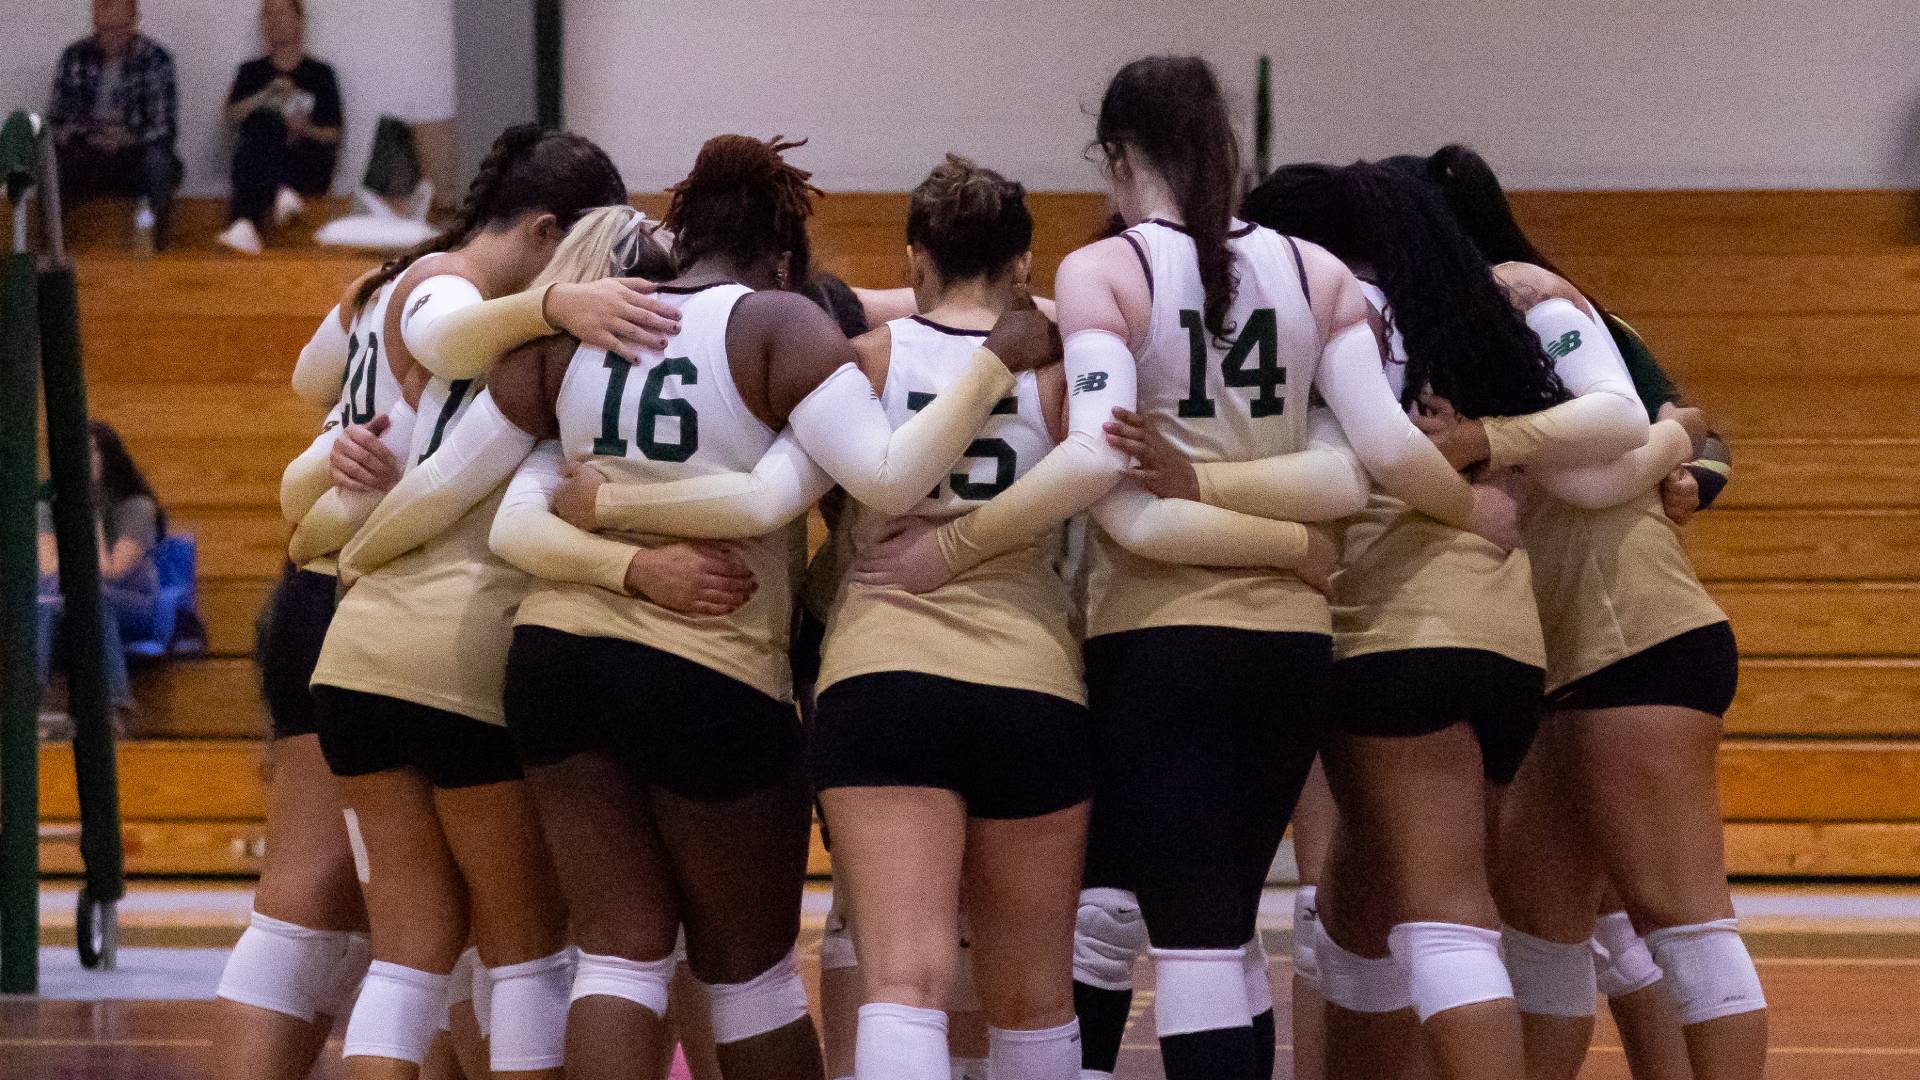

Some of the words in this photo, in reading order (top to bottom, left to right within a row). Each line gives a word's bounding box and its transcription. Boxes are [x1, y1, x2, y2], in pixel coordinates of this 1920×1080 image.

[1073, 371, 1108, 396] NB
[1178, 308, 1286, 418] 14
[1547, 330, 1582, 359] NB
[593, 350, 698, 463] 16
[907, 391, 1018, 500] 5
